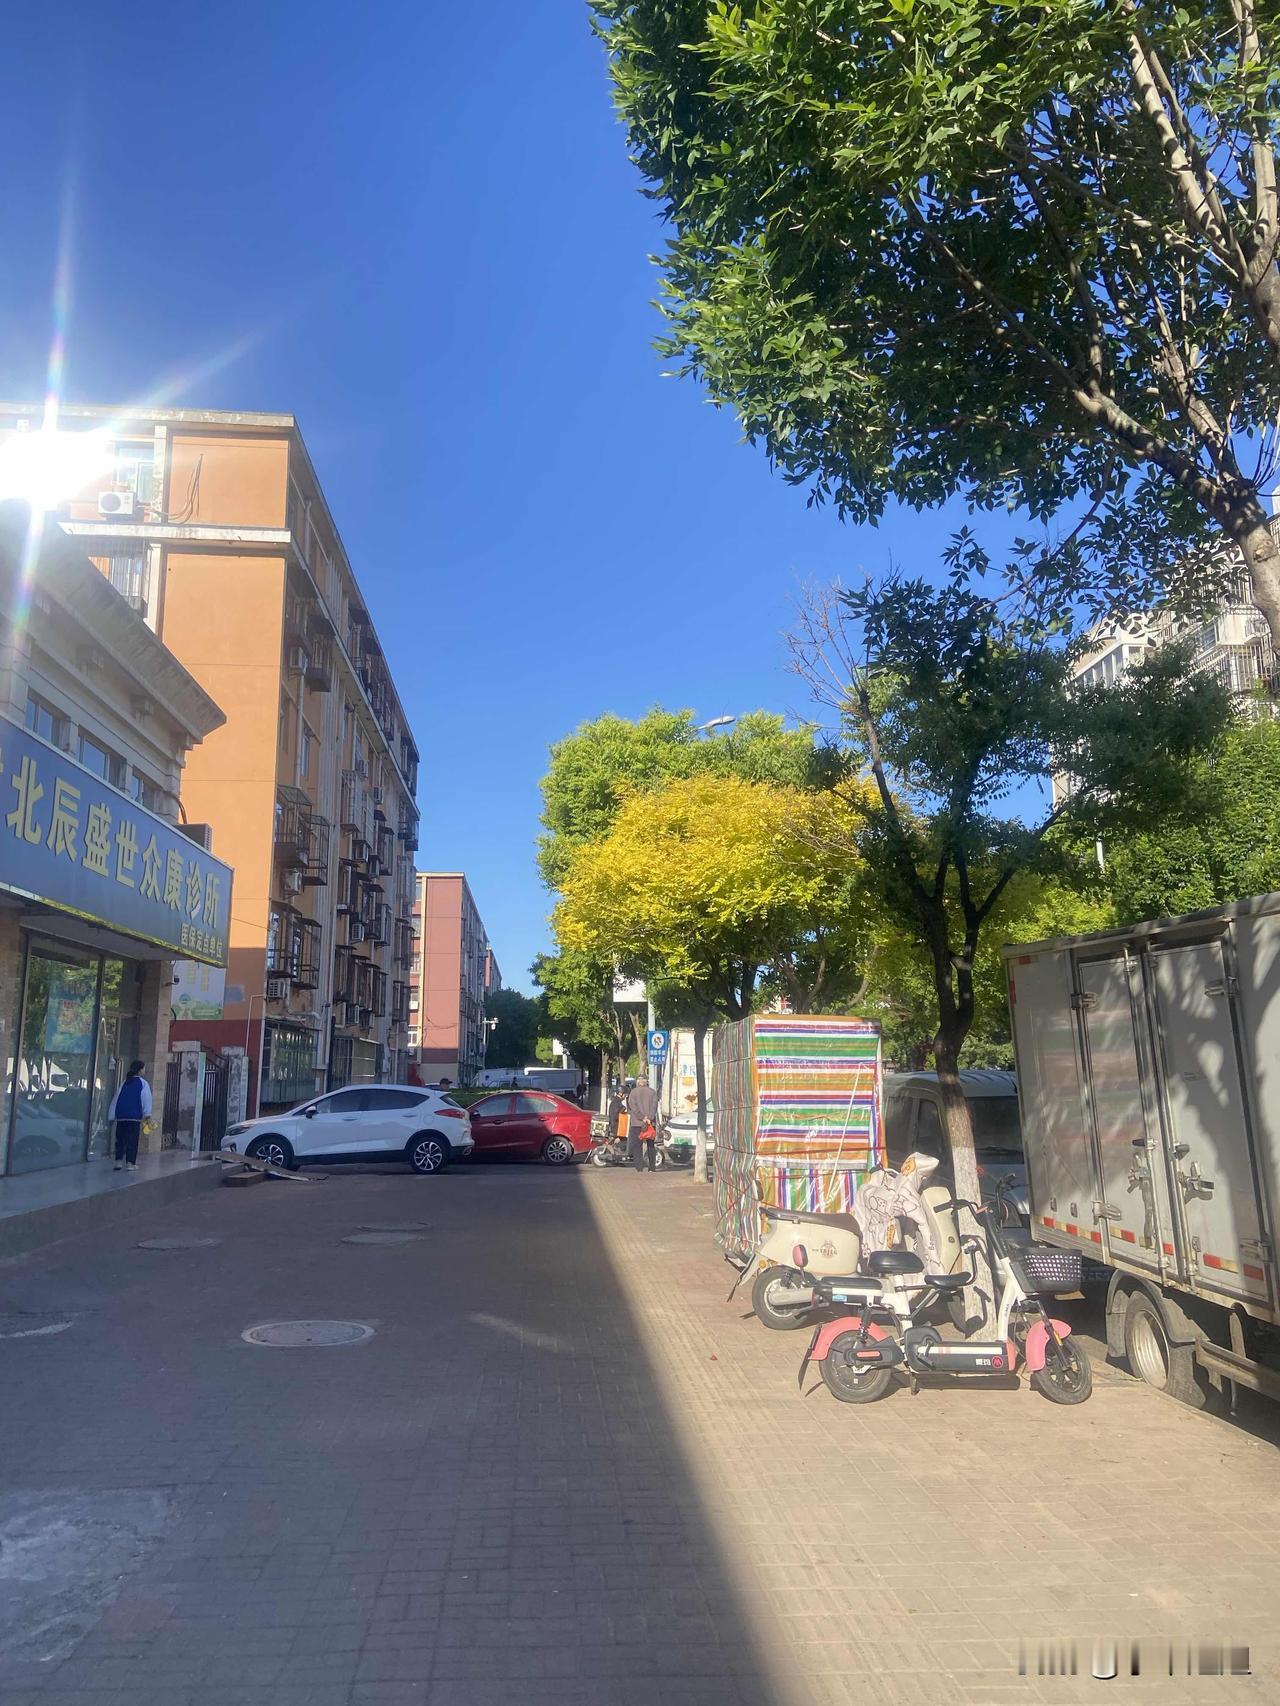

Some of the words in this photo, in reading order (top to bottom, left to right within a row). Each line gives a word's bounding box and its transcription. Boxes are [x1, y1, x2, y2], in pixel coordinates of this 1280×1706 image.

[0, 748, 220, 928] 北辰盛世众康诊所
[180, 922, 223, 958] 医保定点单位
